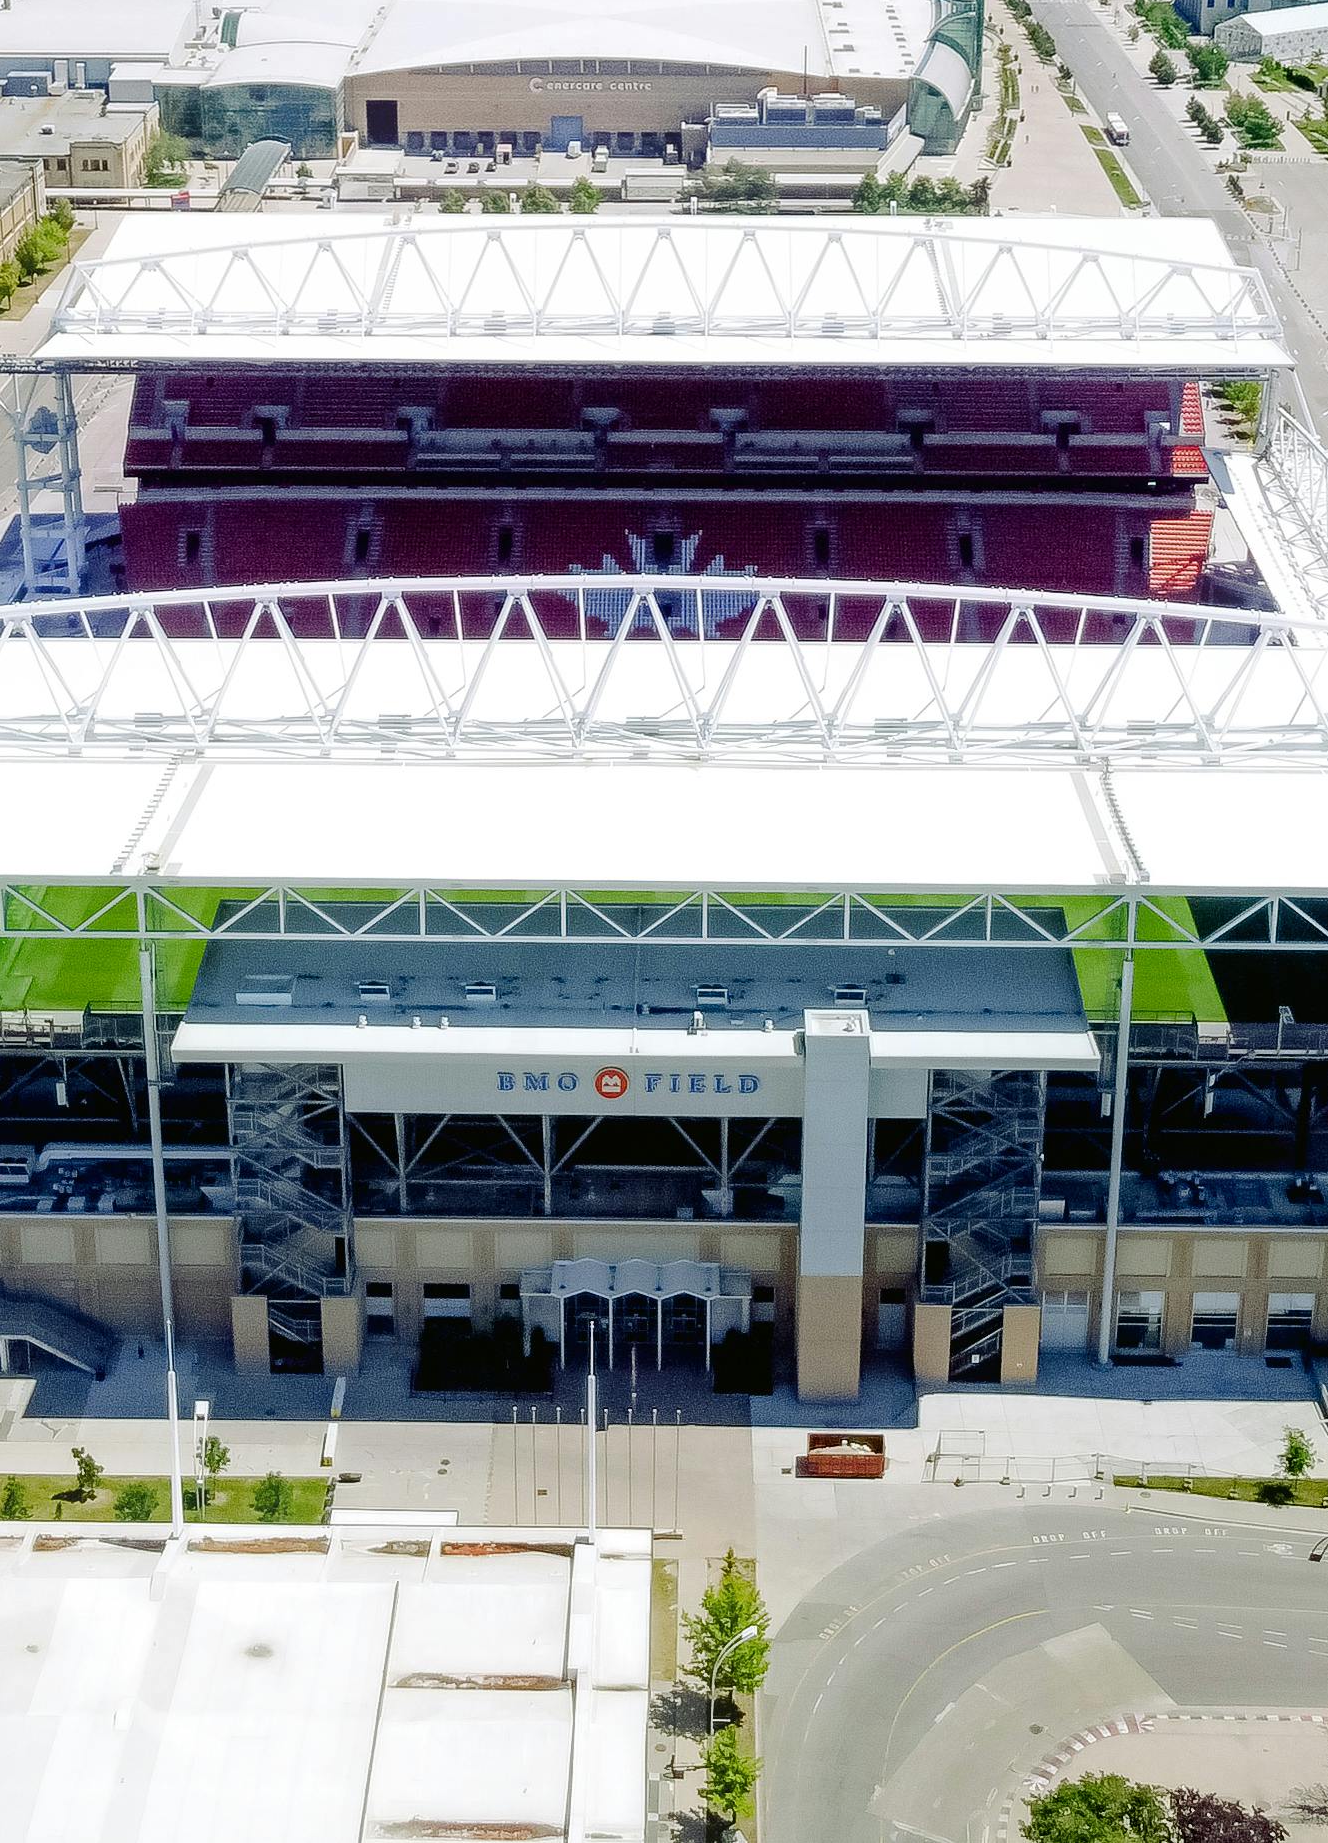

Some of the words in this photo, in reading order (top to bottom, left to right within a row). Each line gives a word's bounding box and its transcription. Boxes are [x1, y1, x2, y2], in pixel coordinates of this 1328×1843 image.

[547, 80, 603, 91] enercare
[610, 80, 652, 91] centre
[497, 1071, 579, 1092] BMO
[643, 1073, 761, 1094] FIELD
[1032, 1533, 1065, 1544] DROP
[1082, 1530, 1107, 1539] OFF
[1154, 1527, 1188, 1535] DROP
